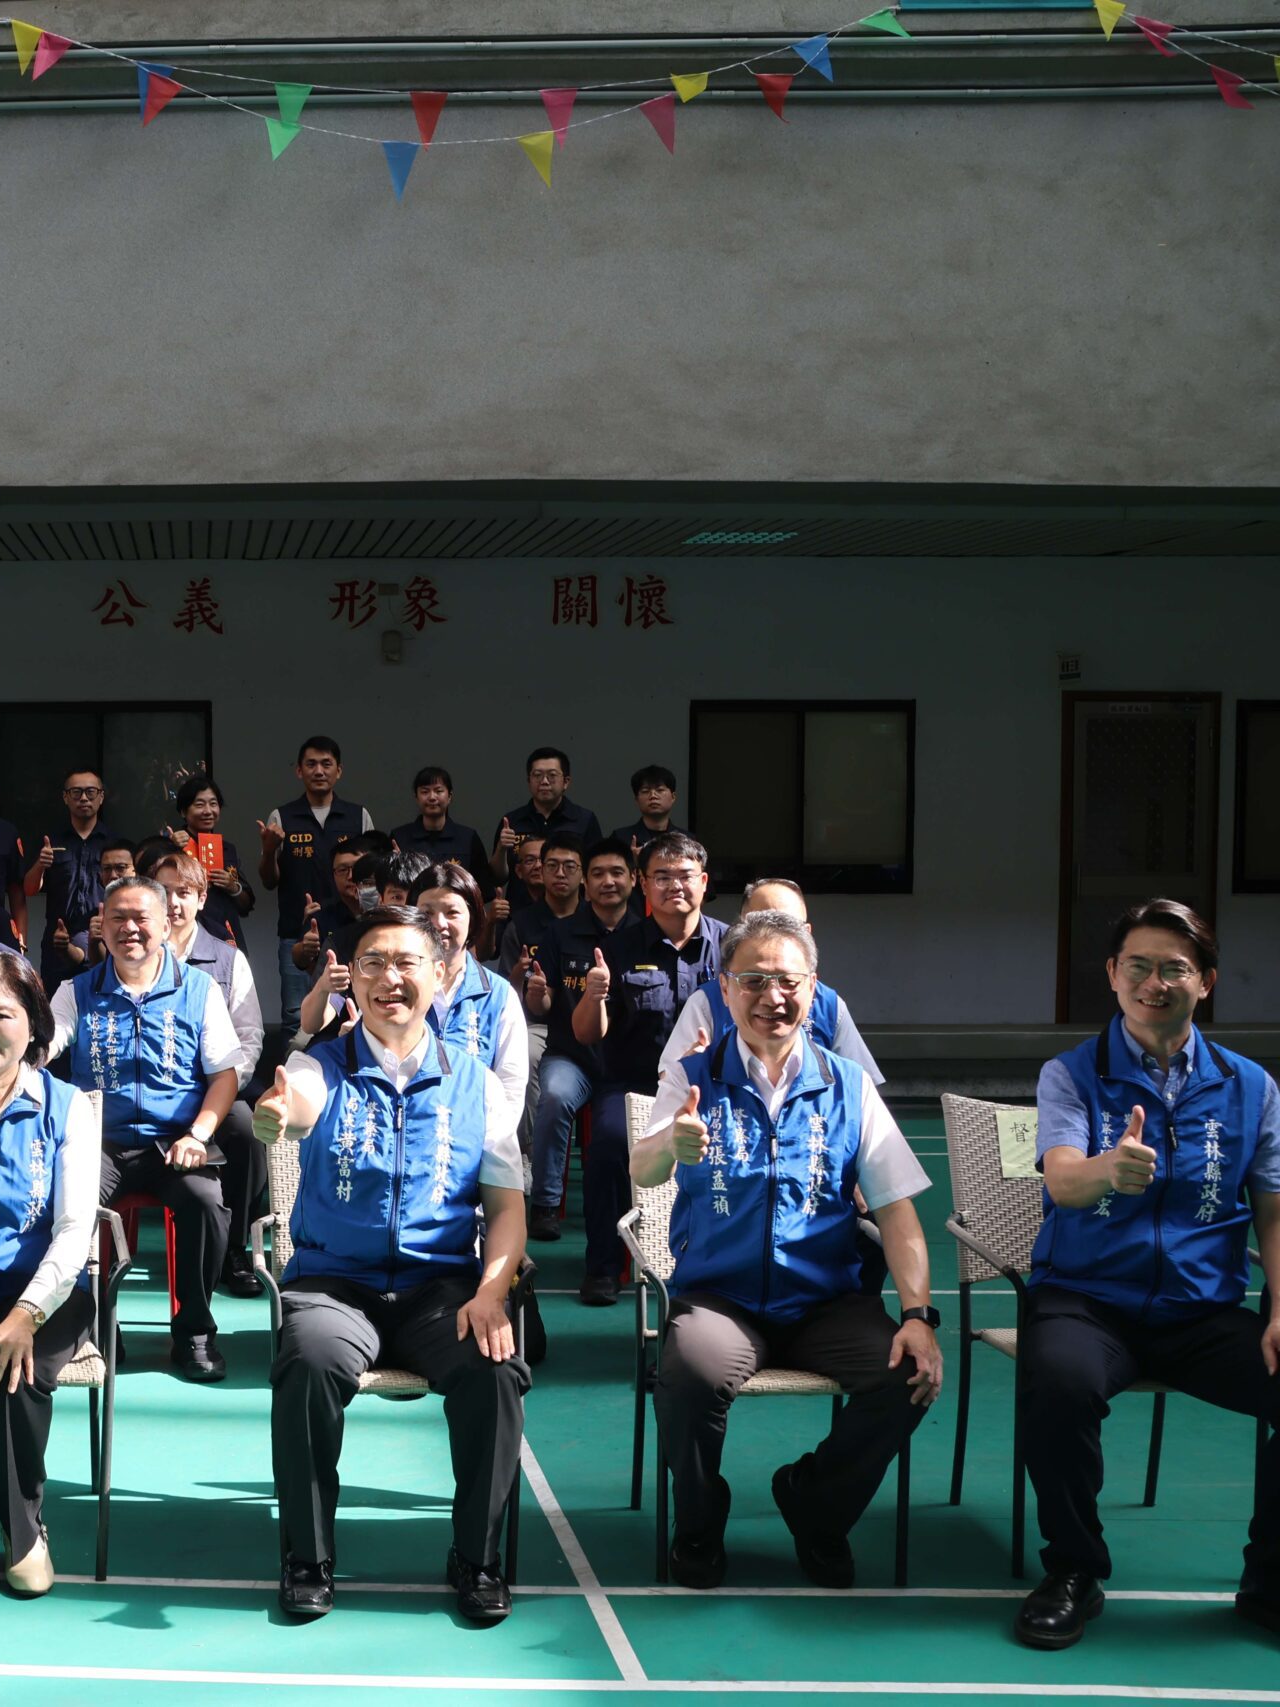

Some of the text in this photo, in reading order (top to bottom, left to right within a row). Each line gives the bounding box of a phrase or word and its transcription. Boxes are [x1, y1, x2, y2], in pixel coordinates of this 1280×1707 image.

[91, 579, 224, 635] 公義
[329, 575, 447, 631] 形象
[551, 575, 676, 631] 關懷
[289, 833, 313, 843] CID
[363, 1101, 381, 1154] 警察局
[431, 1105, 456, 1204] 雲林縣政府
[733, 1108, 750, 1162] 警察局
[1010, 1122, 1038, 1143] 督
[1194, 1118, 1226, 1223] 雲林縣政府
